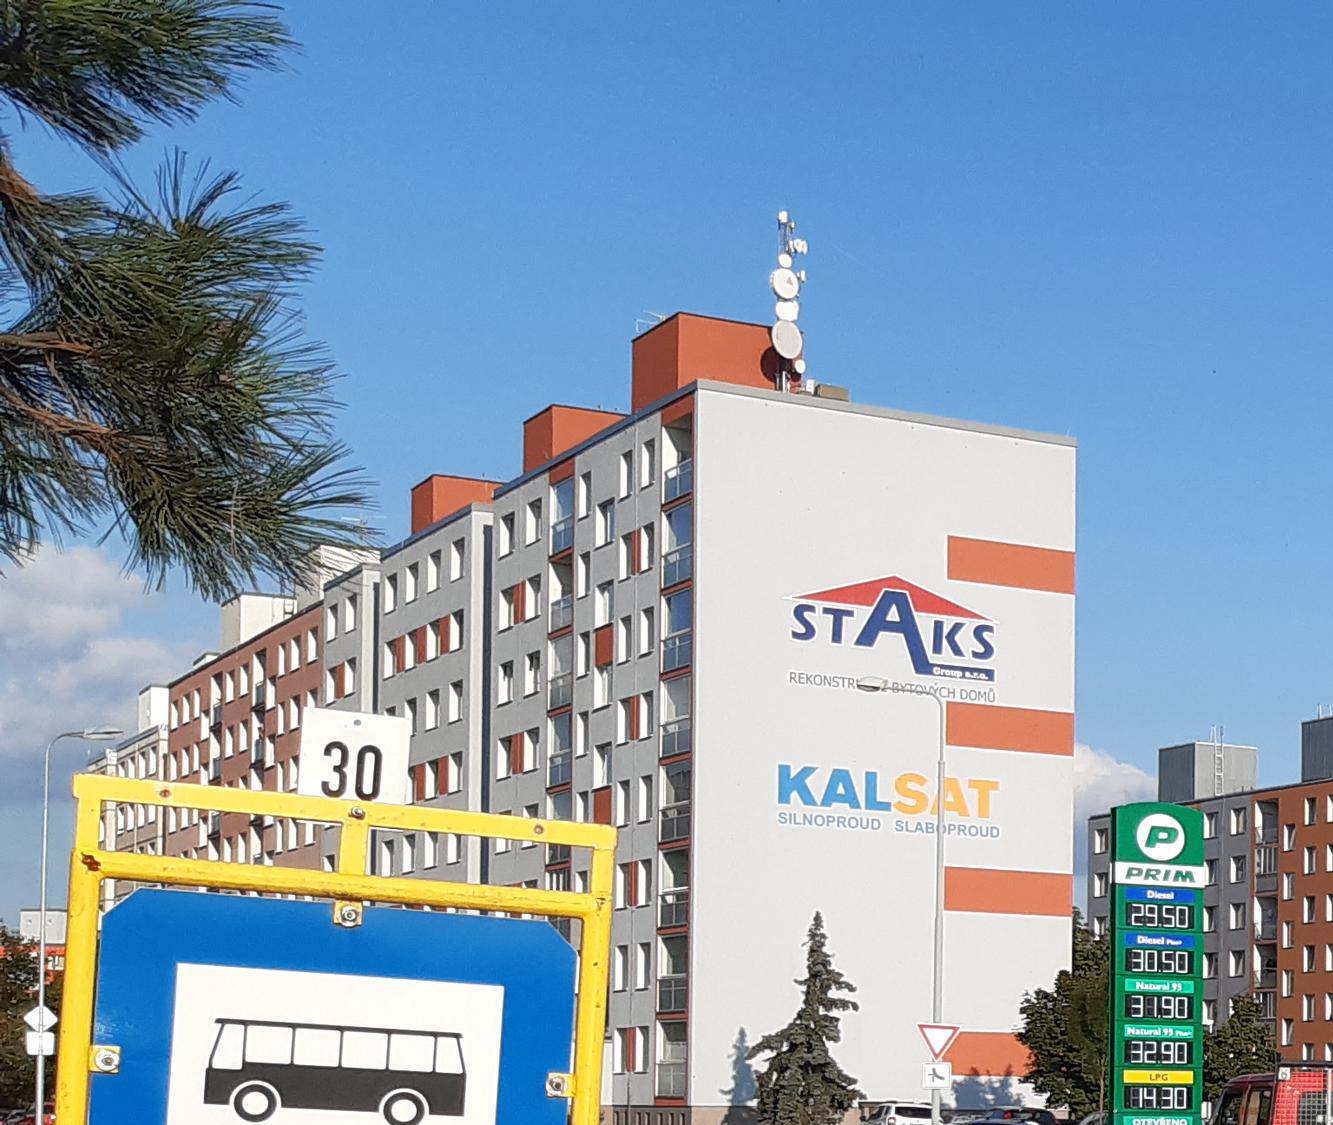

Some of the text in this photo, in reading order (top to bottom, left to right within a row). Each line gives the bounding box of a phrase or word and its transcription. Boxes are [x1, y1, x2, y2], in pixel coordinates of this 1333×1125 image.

[791, 589, 995, 676] STAKS
[932, 666, 990, 681] Group s.r.o.
[891, 681, 956, 699] BYTOVÝCH
[959, 687, 996, 703] DOMŮ
[321, 740, 383, 802] 30
[777, 763, 1000, 819] KALSAT
[777, 811, 882, 831] SILNOPROUD
[1144, 825, 1179, 848] P
[1125, 866, 1196, 884] PRIM
[1146, 889, 1175, 900] Diesel
[1131, 903, 1189, 929] 29.50
[1136, 935, 1165, 945] Diesel
[1131, 949, 1189, 974] 30.50
[1135, 981, 1183, 992] Natural 95
[1131, 995, 1188, 1019] 31.90
[1127, 1026, 1161, 1036] Natural
[1162, 1027, 1174, 1037] 95
[1130, 1040, 1188, 1065] 32.90
[1149, 1073, 1169, 1082] LPG
[1139, 1087, 1188, 1110] 14.30
